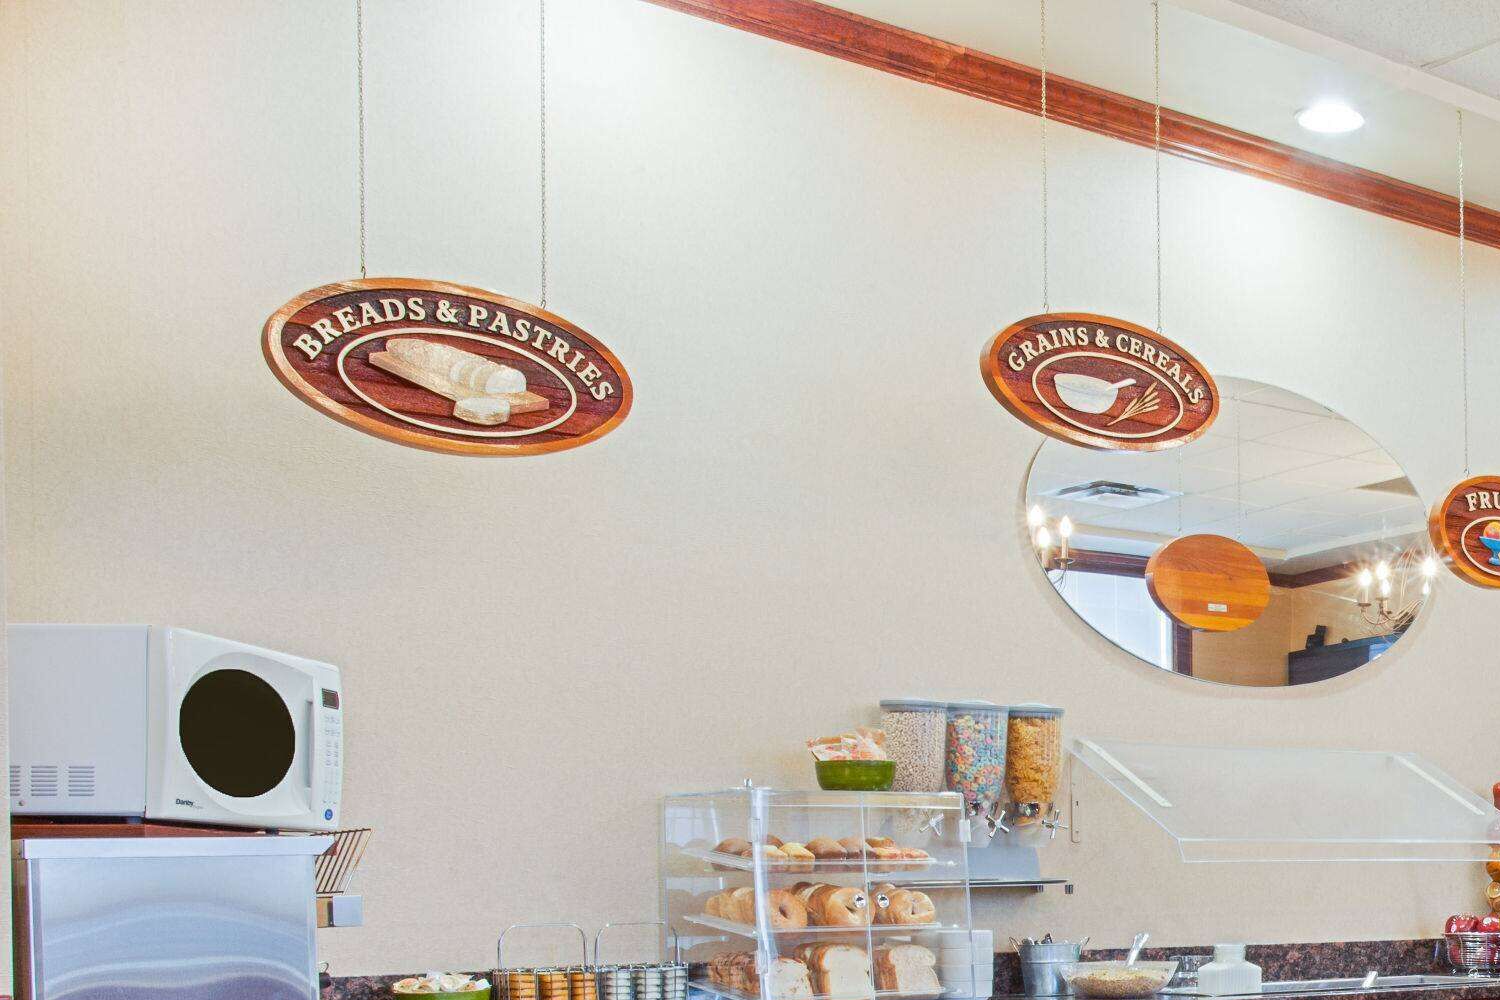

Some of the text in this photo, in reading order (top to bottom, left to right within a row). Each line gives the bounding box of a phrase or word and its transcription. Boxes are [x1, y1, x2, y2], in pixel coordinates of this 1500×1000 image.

[292, 297, 615, 402] BREADS & PASTRIES
[1008, 327, 1204, 404] GRAINS & CEREALS
